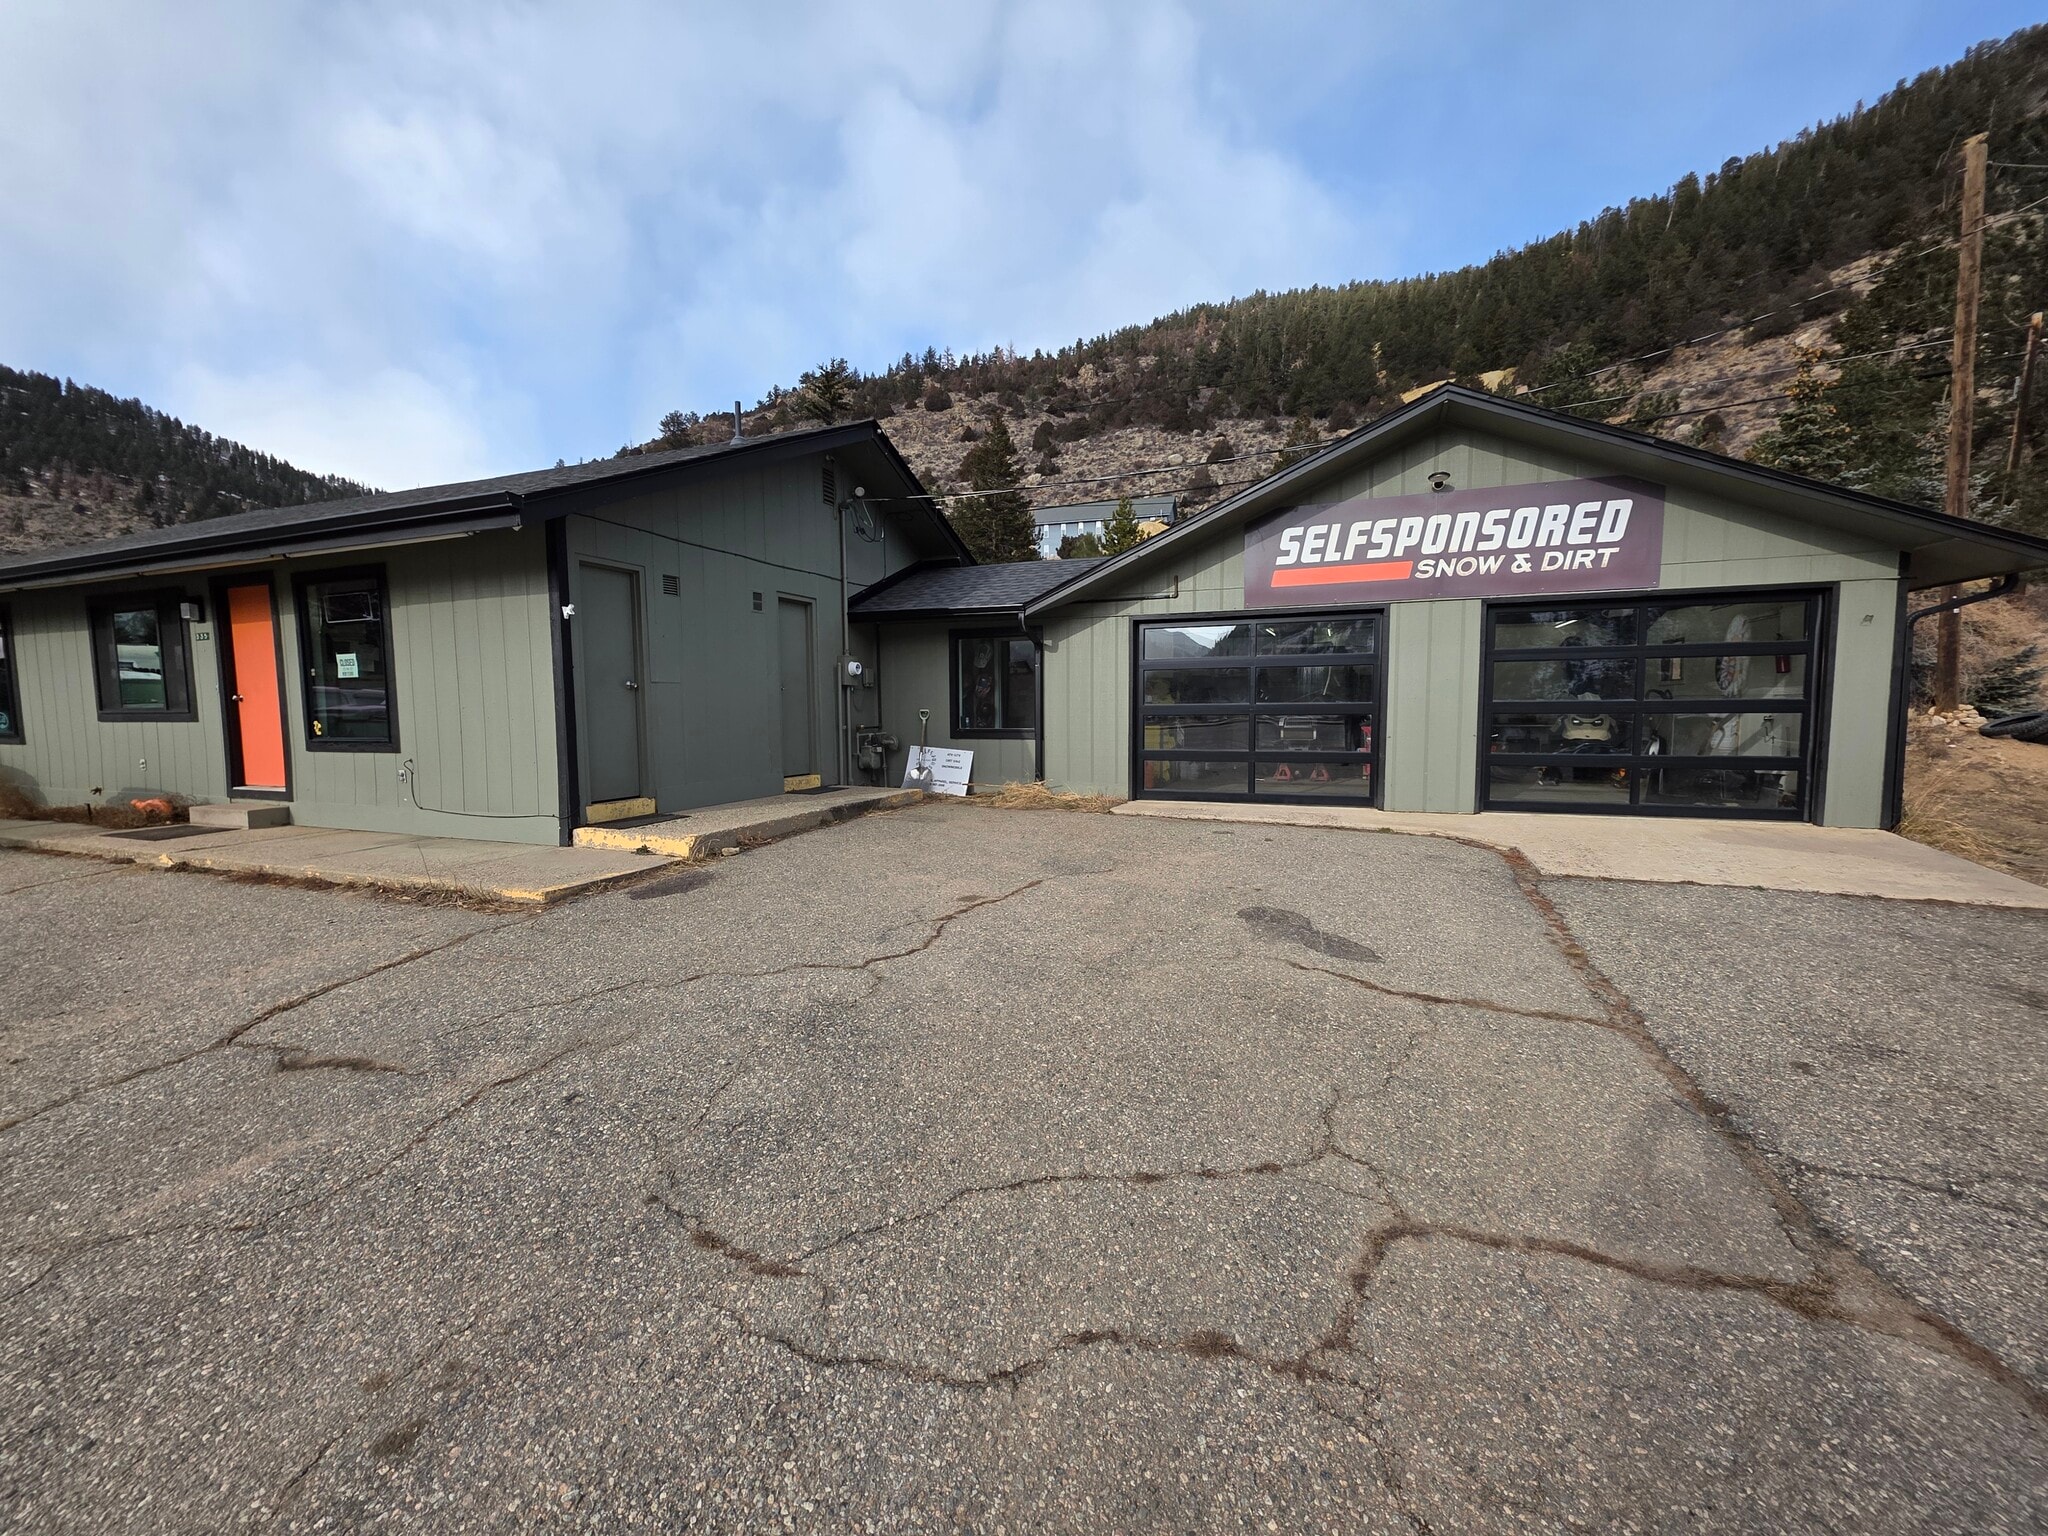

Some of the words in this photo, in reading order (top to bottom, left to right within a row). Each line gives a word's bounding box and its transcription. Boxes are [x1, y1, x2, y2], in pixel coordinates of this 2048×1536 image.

[1275, 498, 1634, 566] SELFSPONSORED
[1414, 556, 1504, 579] SNOW
[1511, 552, 1533, 573] &
[1540, 547, 1620, 572] DIRT
